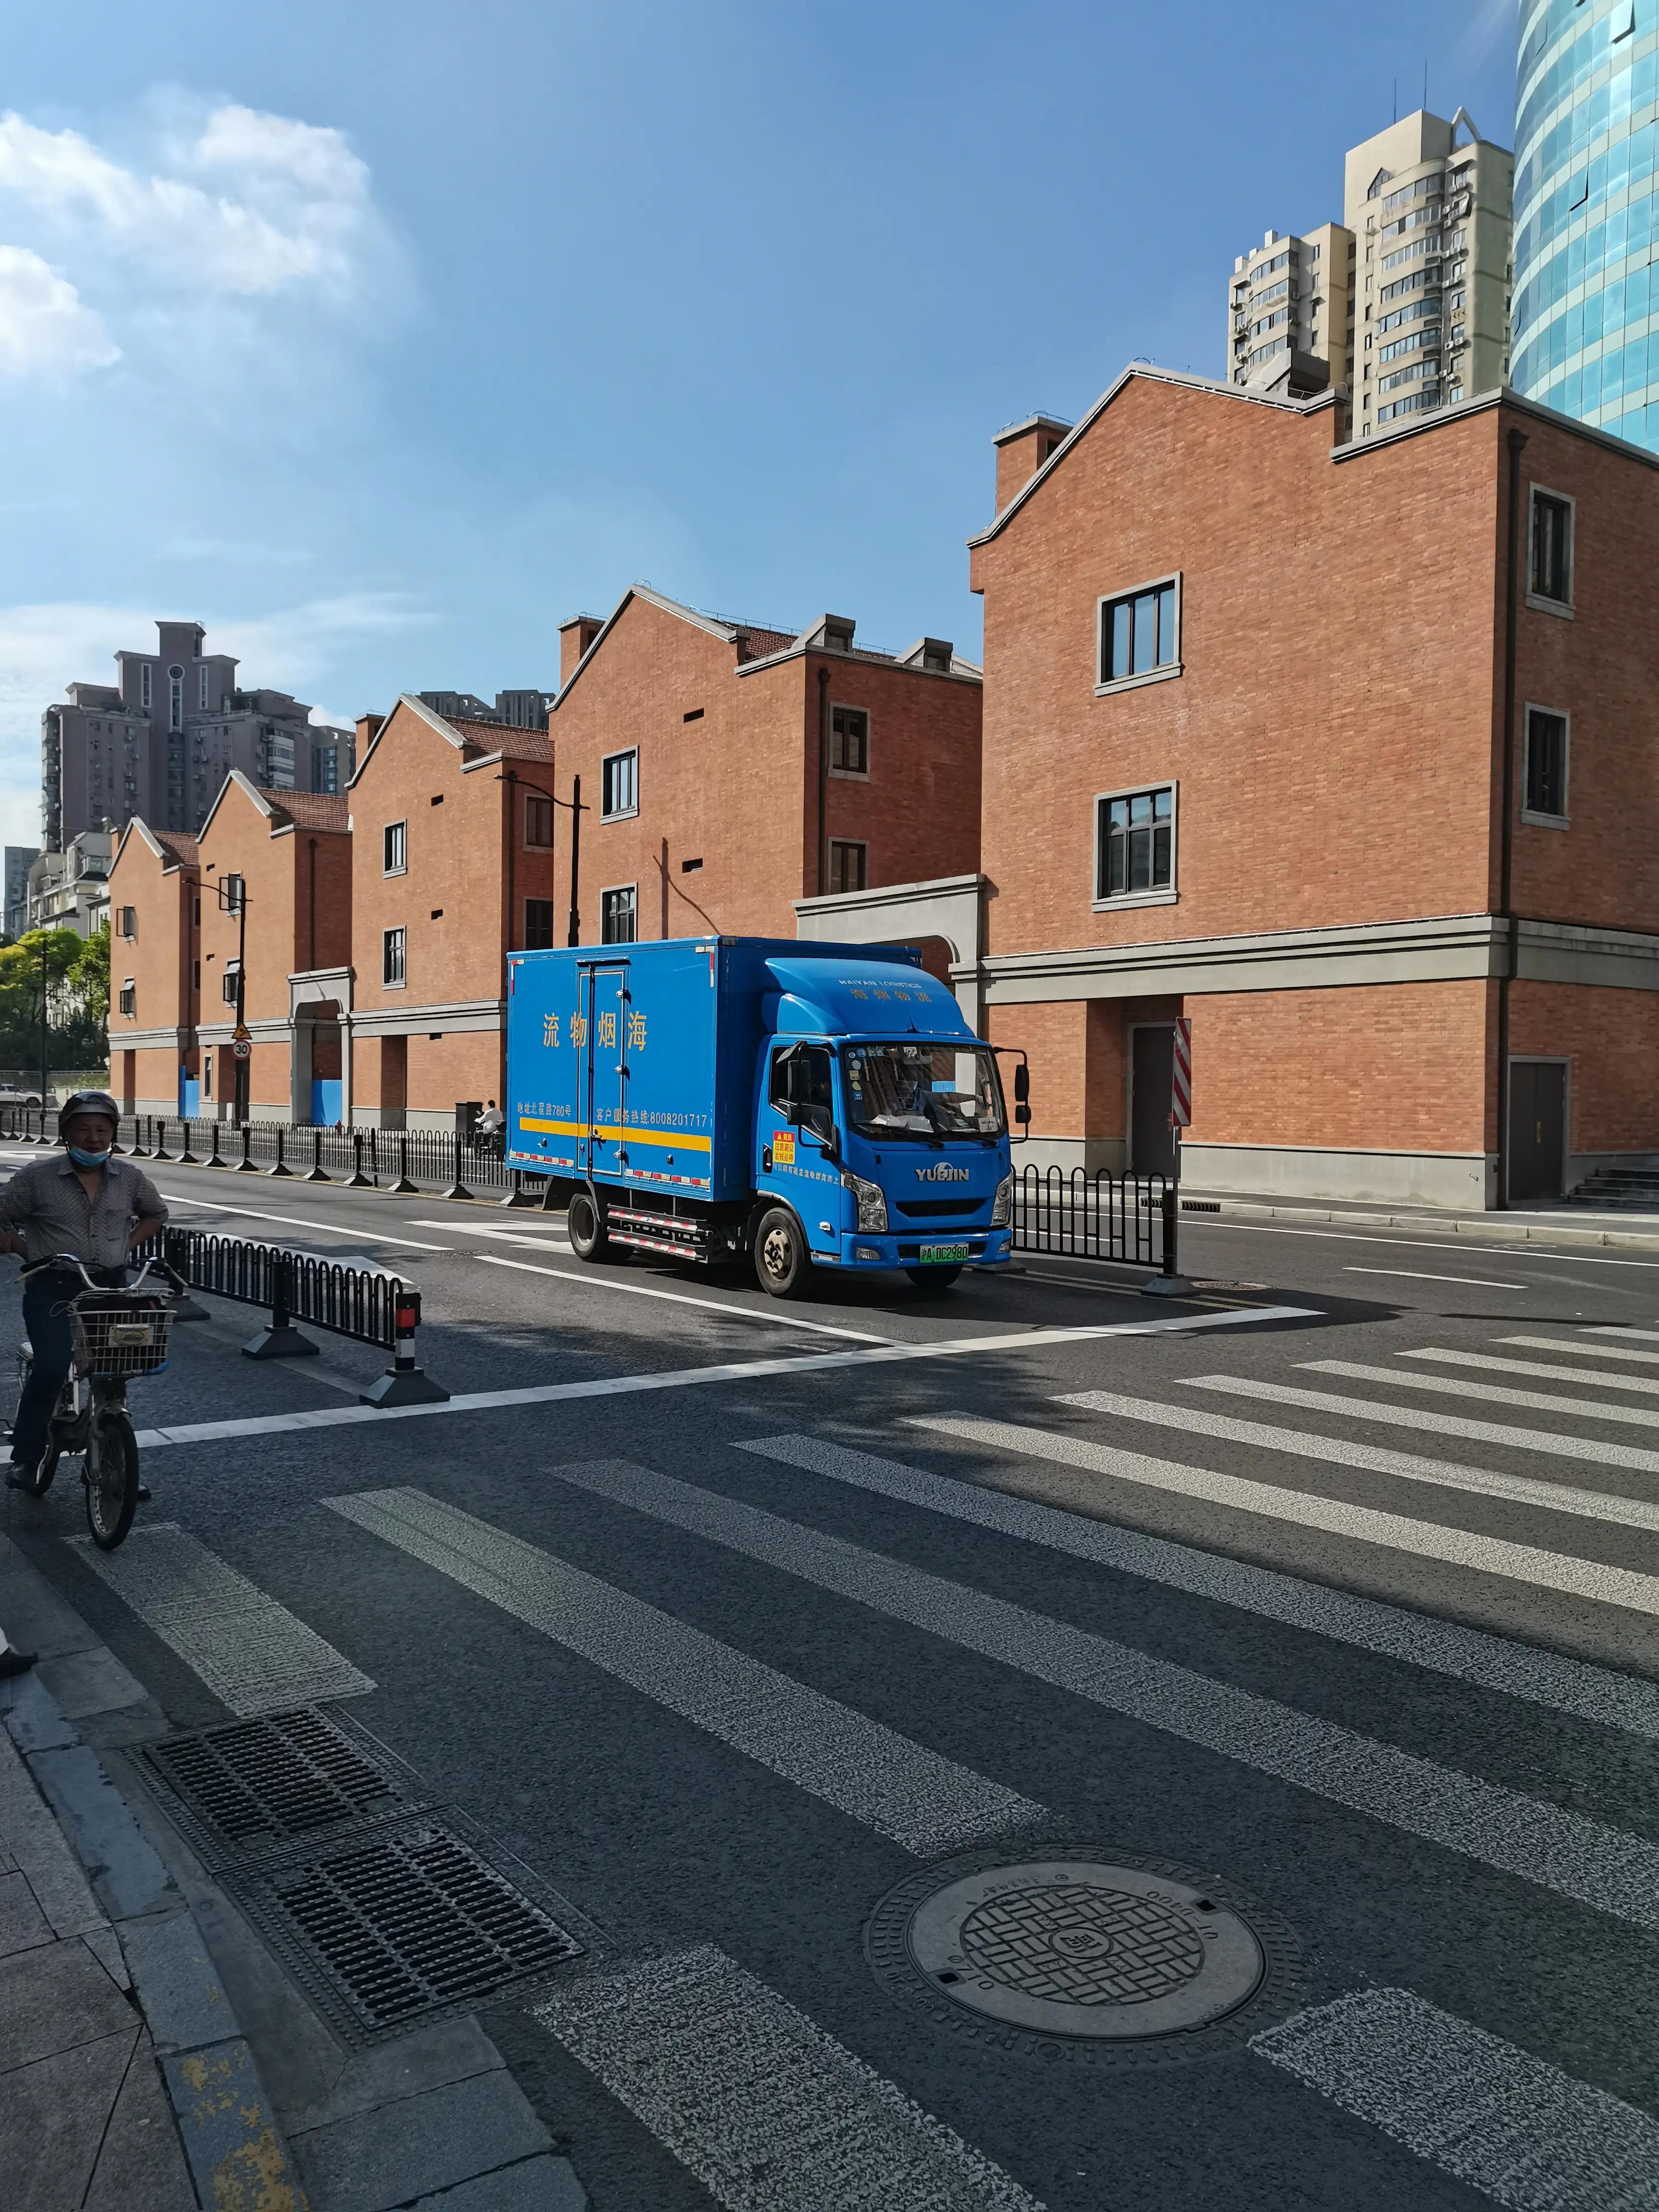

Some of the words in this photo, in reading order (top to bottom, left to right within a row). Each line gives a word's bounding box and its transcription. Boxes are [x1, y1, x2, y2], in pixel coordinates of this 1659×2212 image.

[878, 981, 922, 989] LOGISTICS
[236, 1045, 248, 1054] 30
[915, 1168, 970, 1181] YUEJIN
